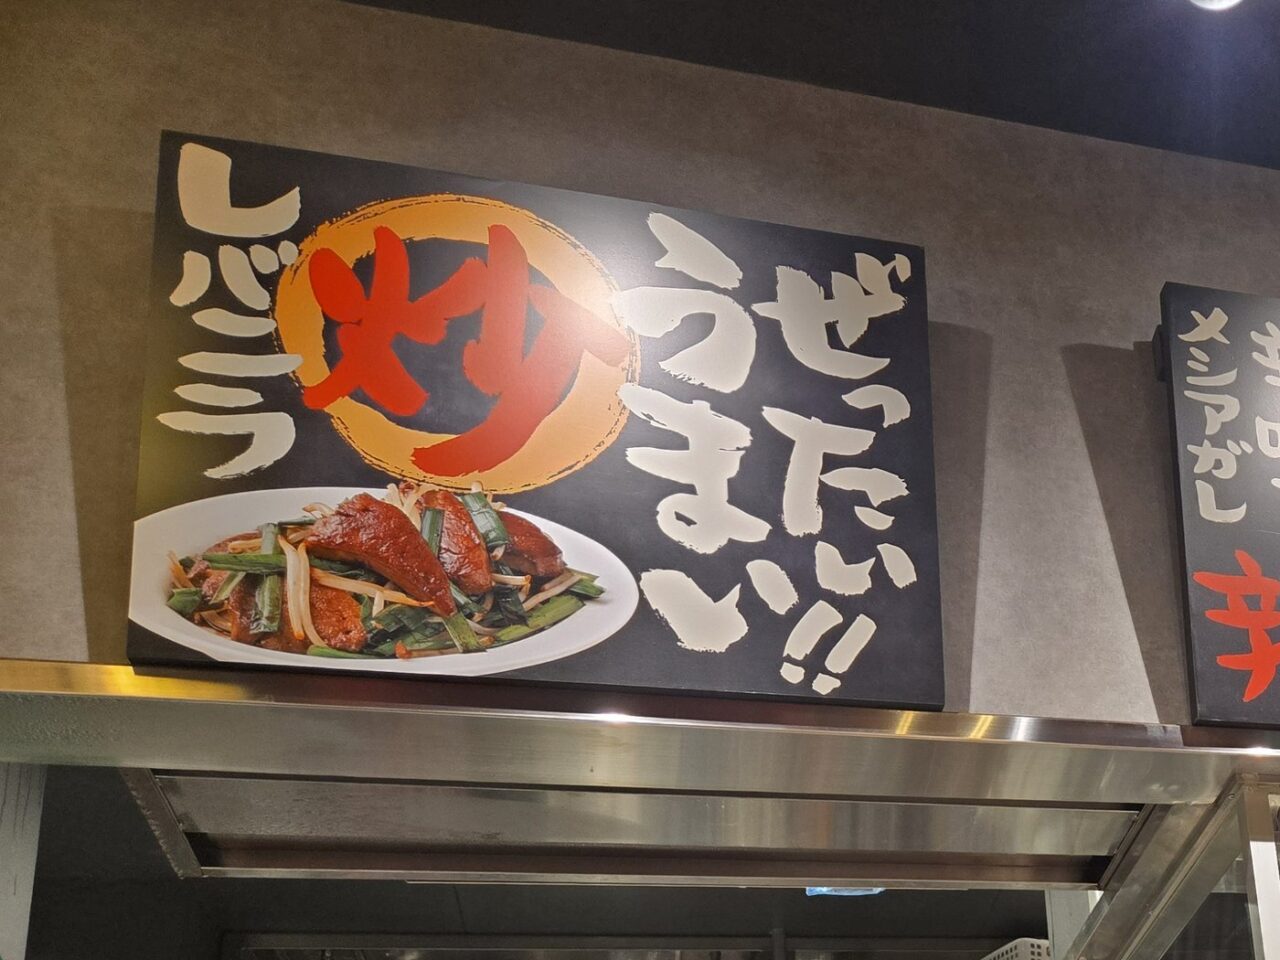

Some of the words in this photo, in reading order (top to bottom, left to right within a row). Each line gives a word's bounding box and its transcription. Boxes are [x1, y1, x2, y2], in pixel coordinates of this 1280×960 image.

[157, 142, 303, 479] レバニラ
[303, 224, 629, 476] 炒
